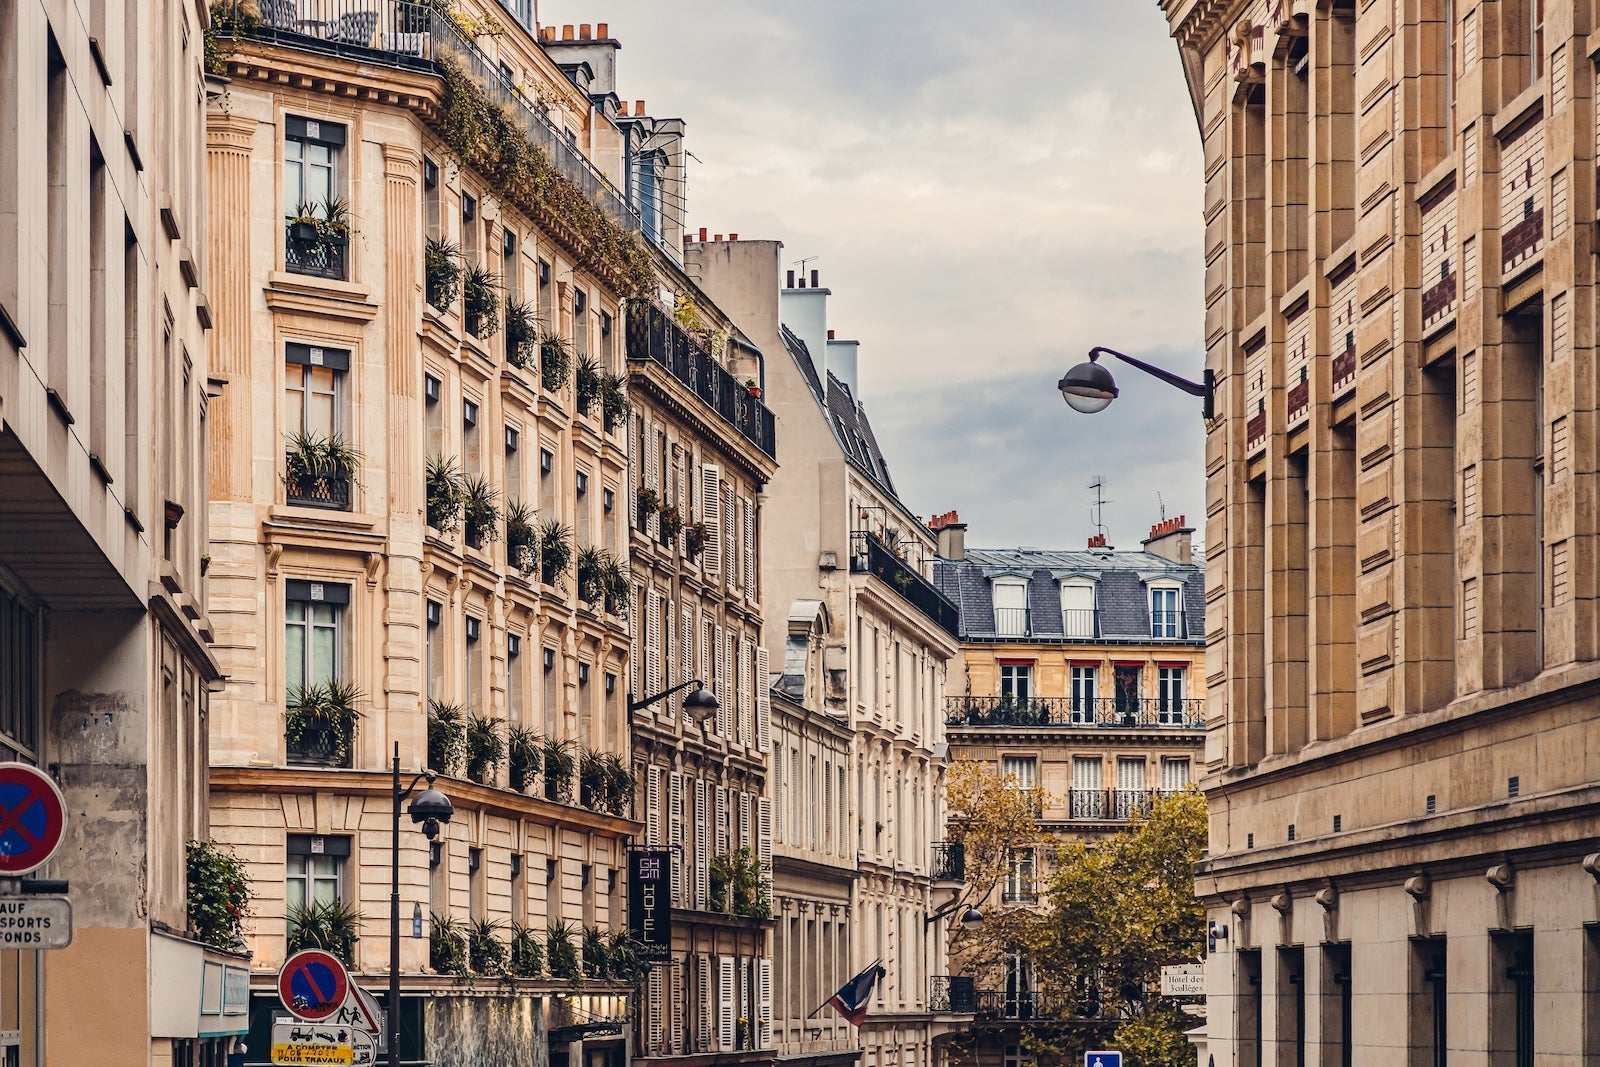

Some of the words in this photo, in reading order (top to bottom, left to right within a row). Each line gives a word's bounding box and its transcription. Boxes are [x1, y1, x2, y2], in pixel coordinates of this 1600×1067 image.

[0, 903, 25, 914] AUF
[0, 917, 51, 928] SPORTS
[1191, 975, 1204, 983] des
[305, 1056, 346, 1064] TRAVAUX
